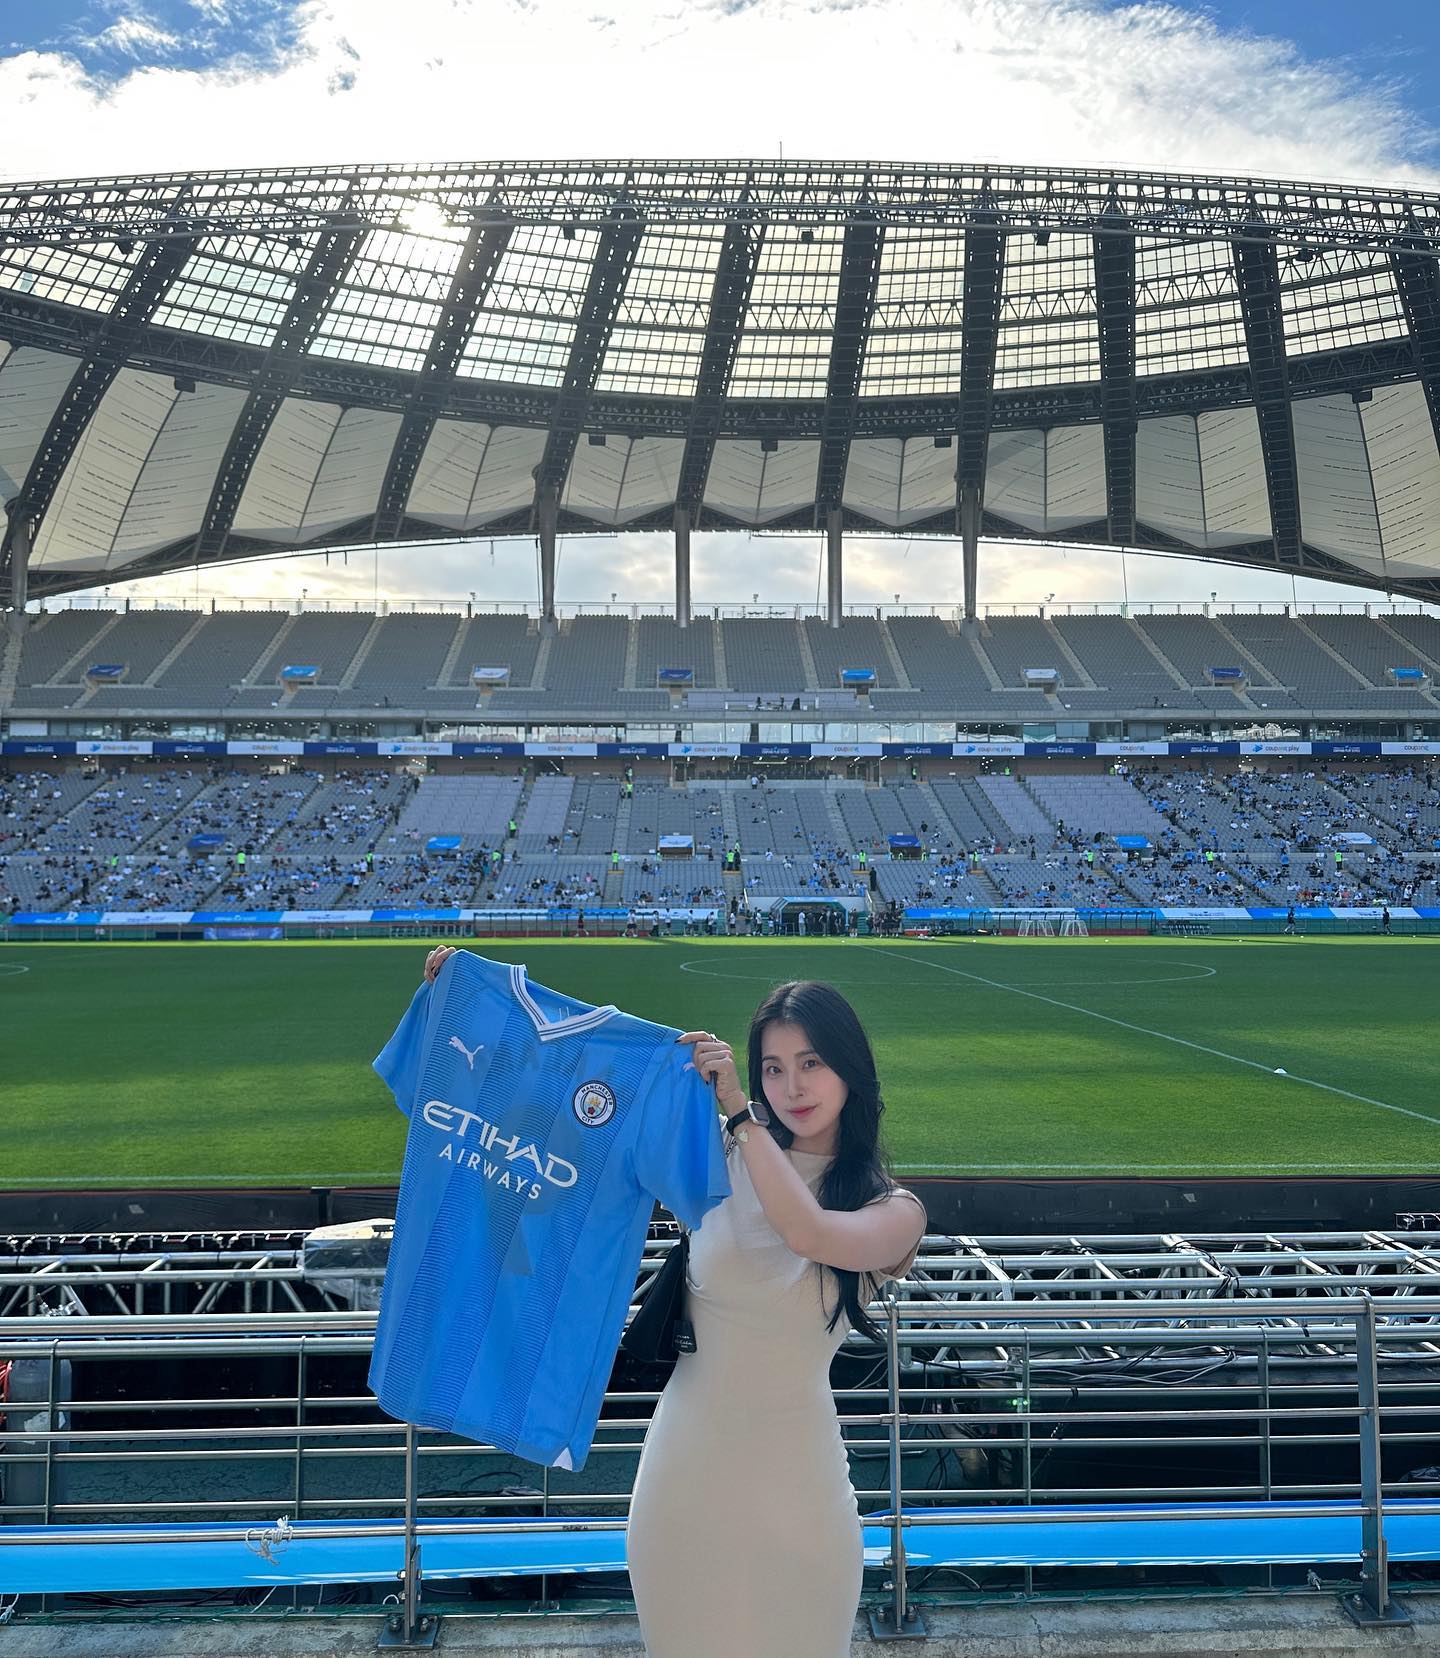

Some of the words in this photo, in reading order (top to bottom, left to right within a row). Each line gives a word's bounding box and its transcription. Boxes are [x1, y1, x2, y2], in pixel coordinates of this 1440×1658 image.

[581, 1084, 613, 1106] MANCHESTER
[581, 1115, 594, 1125] CITY
[422, 1100, 579, 1188] ETIHAD
[439, 1143, 542, 1200] AIRWAYS
